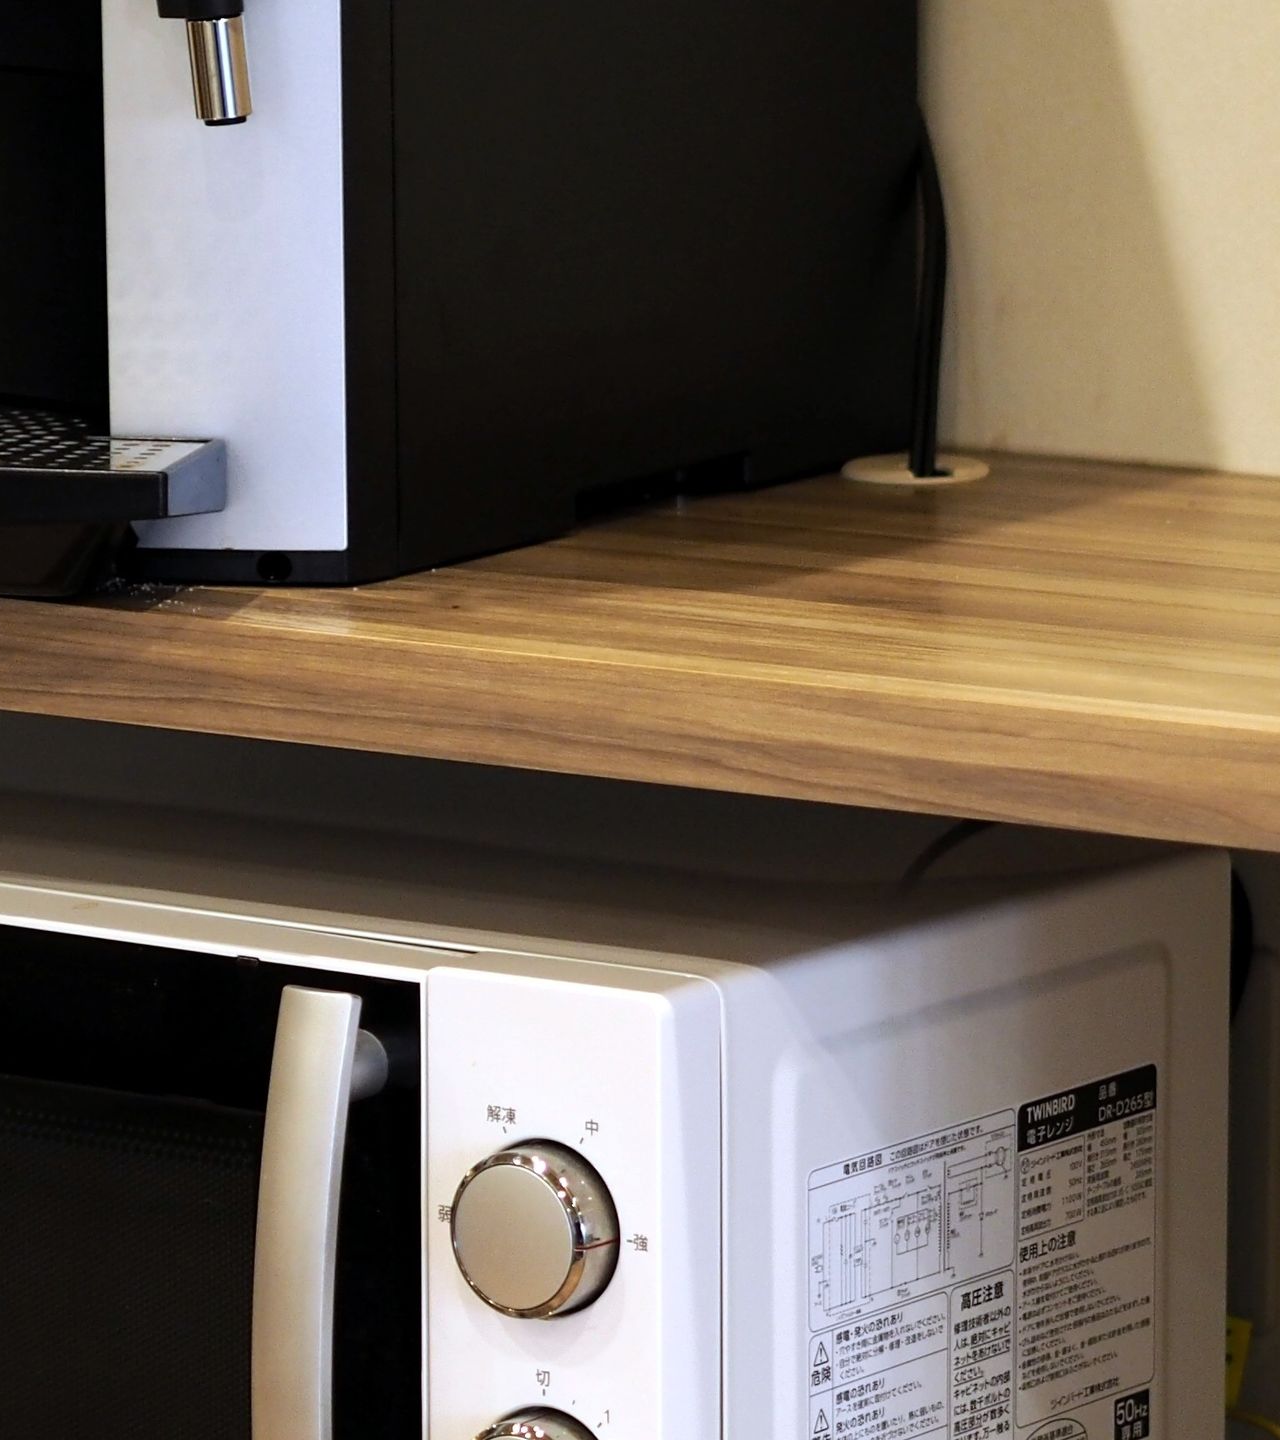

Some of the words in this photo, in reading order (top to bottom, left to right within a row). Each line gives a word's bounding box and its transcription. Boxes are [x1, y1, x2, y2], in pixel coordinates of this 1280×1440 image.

[486, 1104, 517, 1125] 解凍
[1026, 1094, 1076, 1124] TWINBIRD
[1098, 1090, 1153, 1122] DR-D265型
[584, 1118, 600, 1136] 中
[1026, 1116, 1074, 1145] 電子レンジ
[633, 1233, 649, 1252] 強
[1019, 1230, 1076, 1263] 使用上の注意
[960, 1280, 1004, 1312] 高圧注意
[536, 1368, 551, 1387] 切
[811, 1365, 832, 1387] 危険
[604, 1409, 611, 1424] 1
[836, 1406, 886, 1435] 発火の恐れあり
[1116, 1398, 1148, 1425] 50Hz
